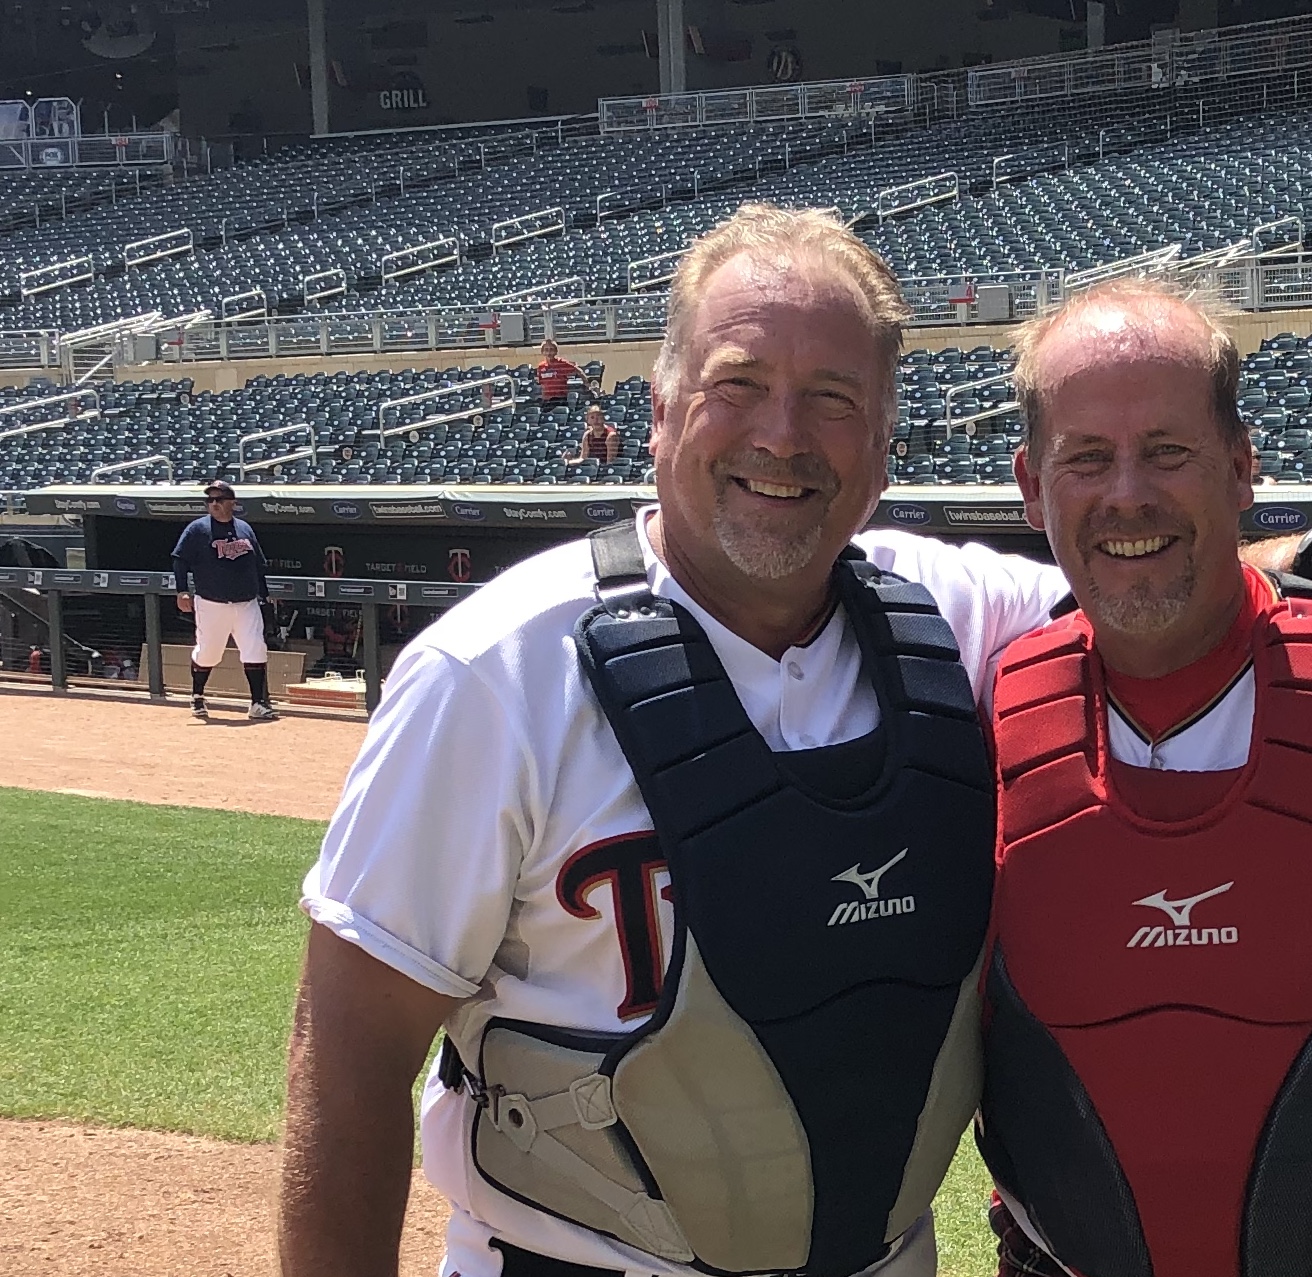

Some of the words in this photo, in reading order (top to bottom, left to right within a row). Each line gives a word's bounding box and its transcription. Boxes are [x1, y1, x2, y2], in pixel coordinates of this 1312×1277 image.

[380, 89, 427, 109] GRILL
[586, 506, 615, 517] Carrier
[892, 507, 925, 520] Carrier
[1260, 513, 1301, 524] Carrier
[827, 895, 915, 927] MIZUNO
[1126, 925, 1239, 948] MIZUNO
